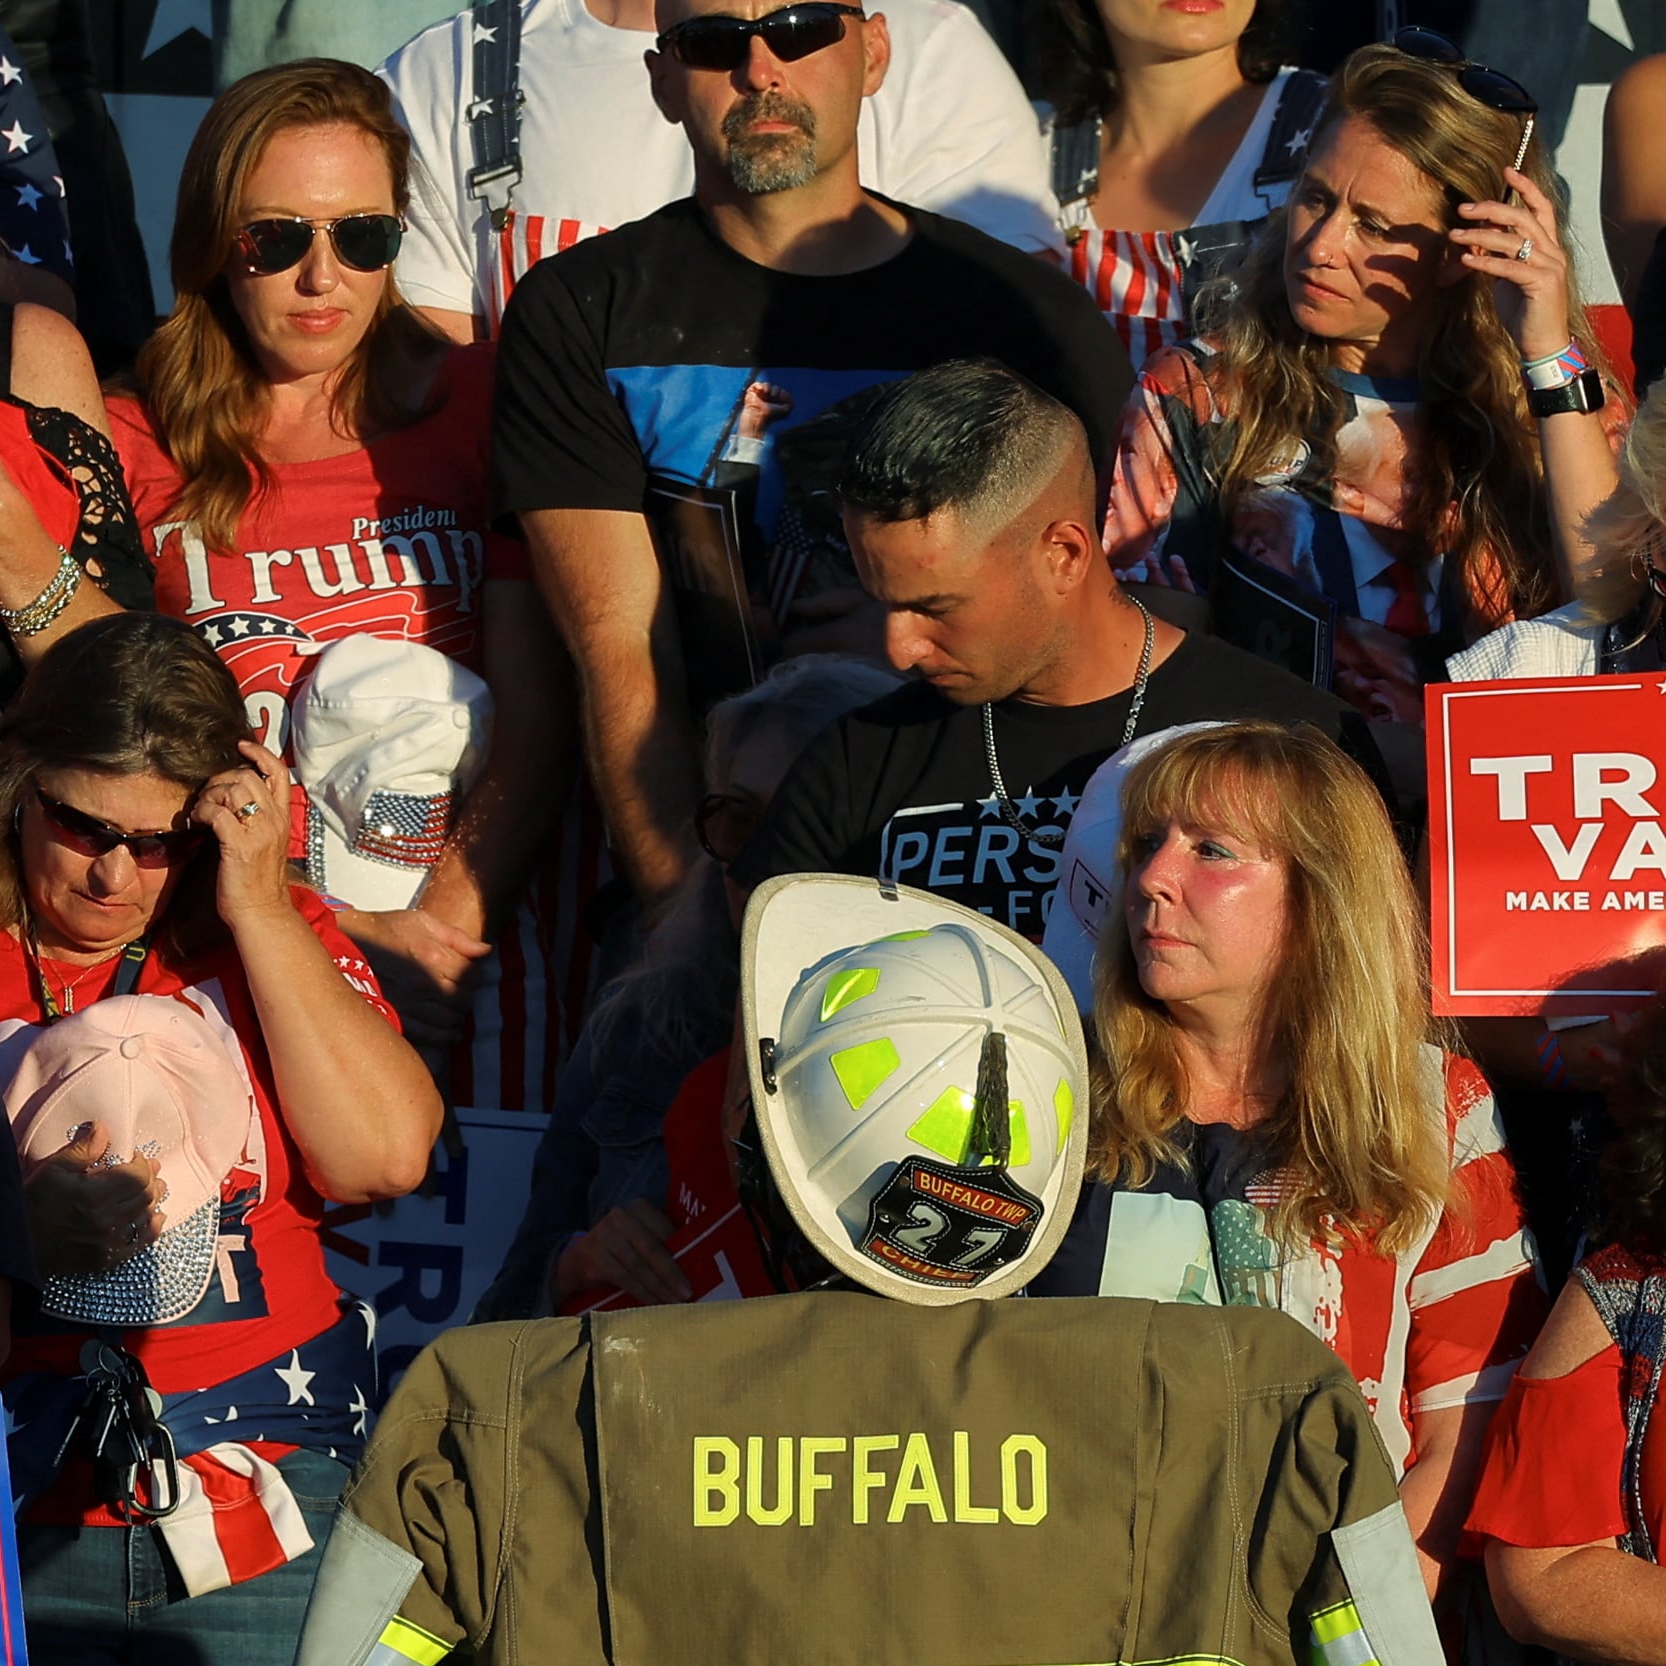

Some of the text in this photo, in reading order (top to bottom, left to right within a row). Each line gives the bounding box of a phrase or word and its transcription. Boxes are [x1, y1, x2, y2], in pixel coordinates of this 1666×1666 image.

[350, 506, 459, 541] President
[153, 518, 483, 616] Trump
[1505, 889, 1591, 914] MAKE
[917, 1171, 1028, 1221] BUFFALO TWP
[899, 1203, 1008, 1267] 27
[879, 1243, 974, 1282] CHIEF
[694, 1432, 1048, 1527] BUFFALO
